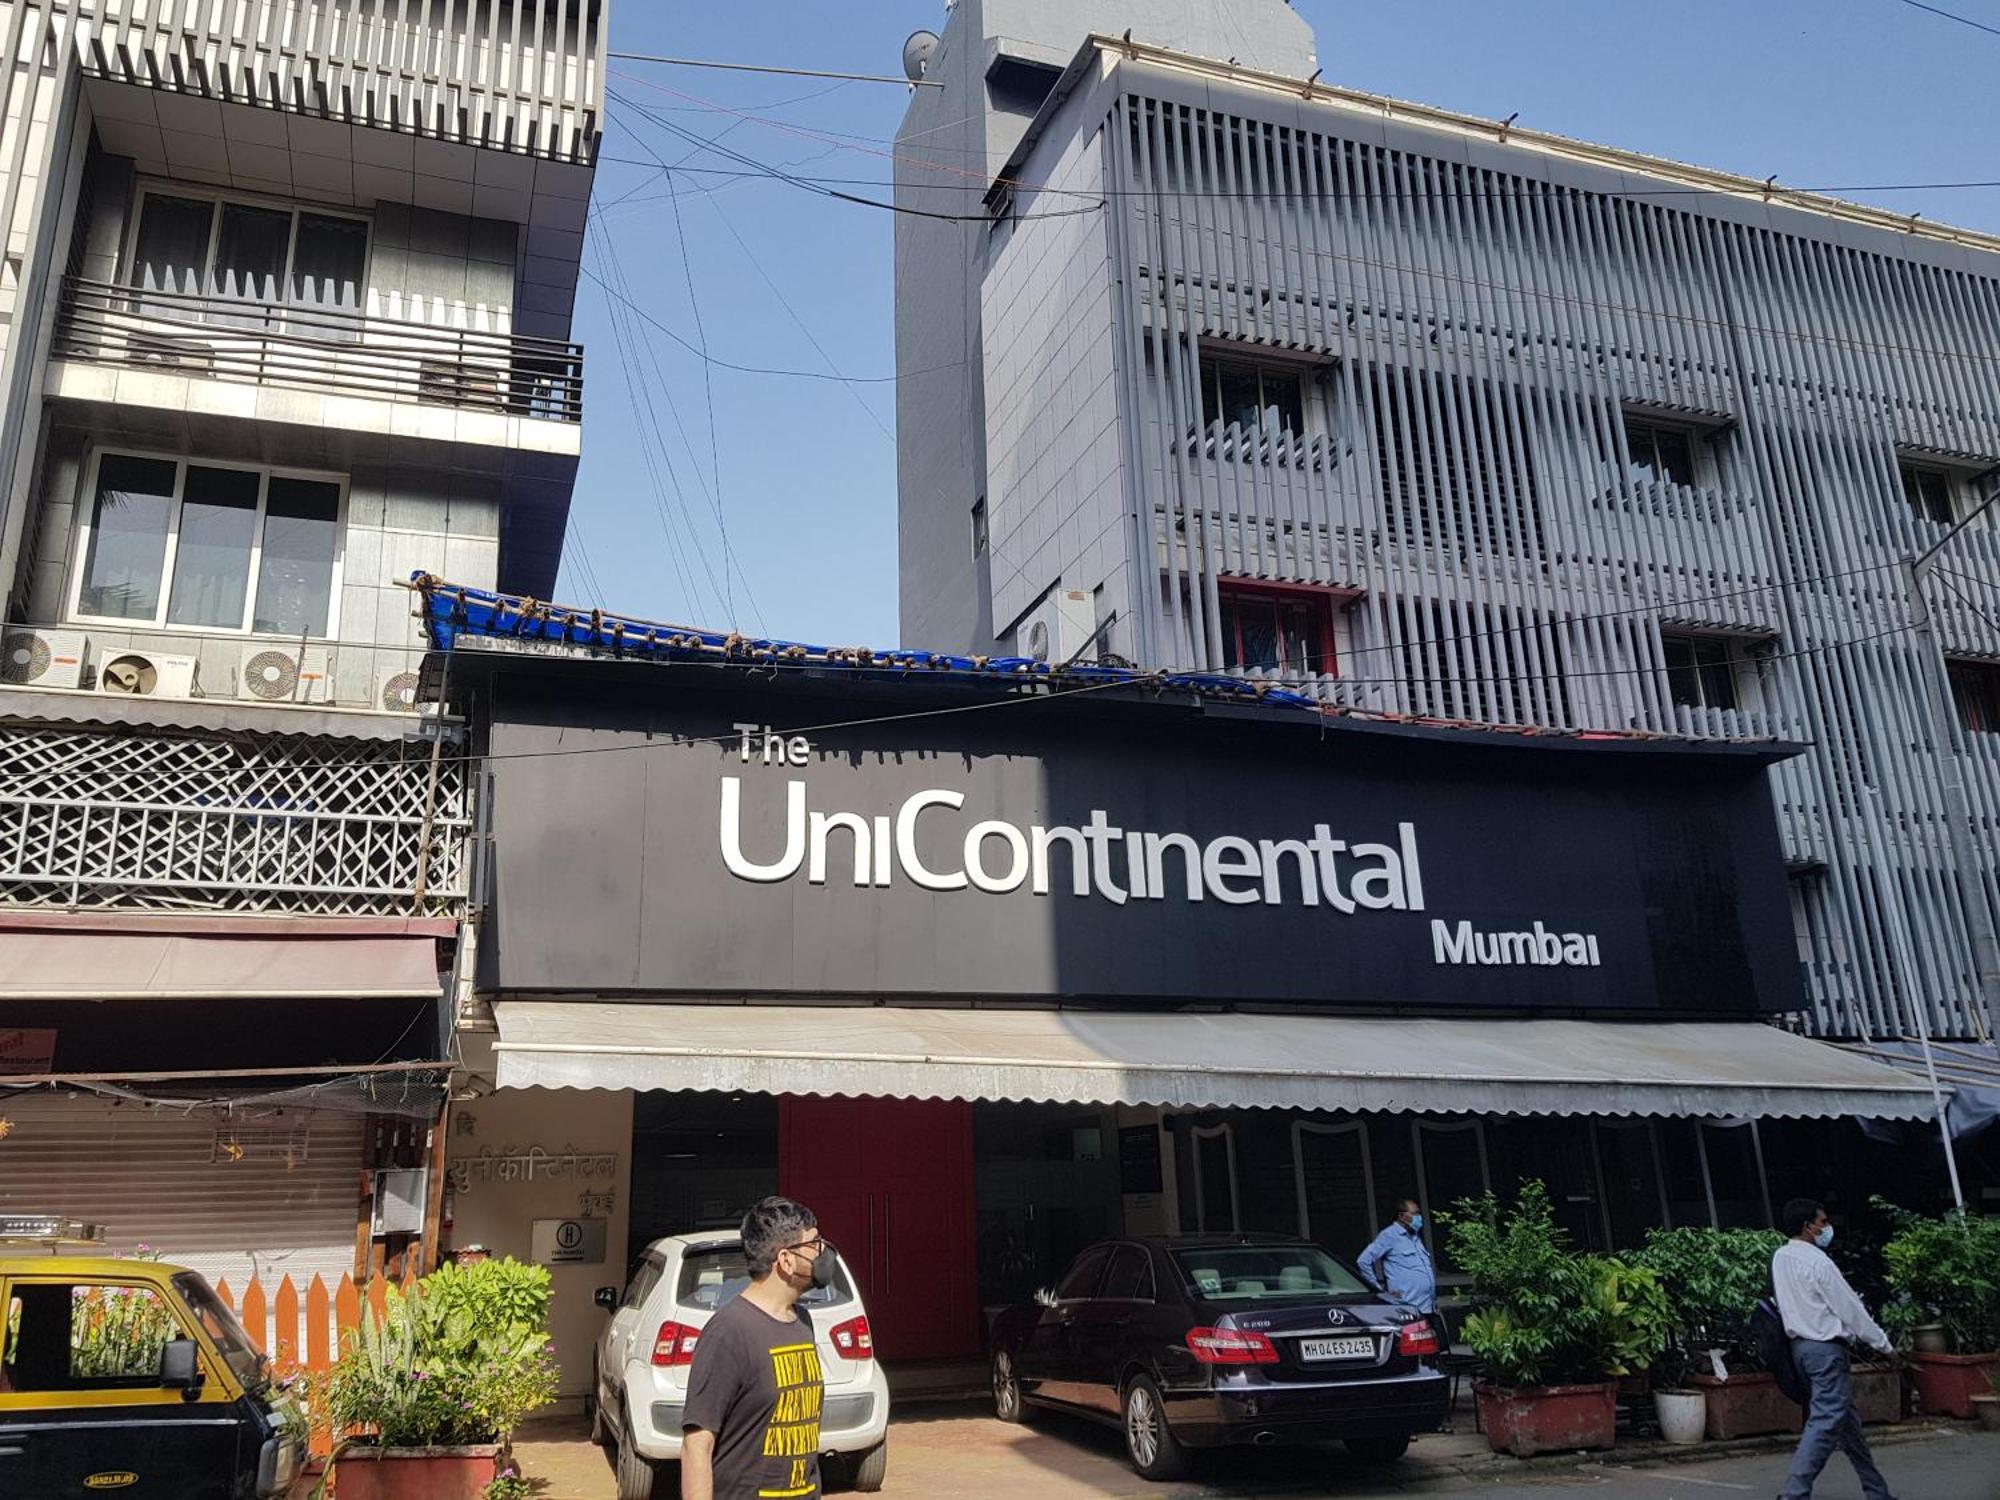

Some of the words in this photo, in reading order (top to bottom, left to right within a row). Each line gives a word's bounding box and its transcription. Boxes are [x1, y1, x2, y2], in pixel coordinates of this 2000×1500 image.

[733, 722, 810, 767] The
[719, 776, 1425, 914] UniContinental
[1431, 919, 1601, 966] Mumbai
